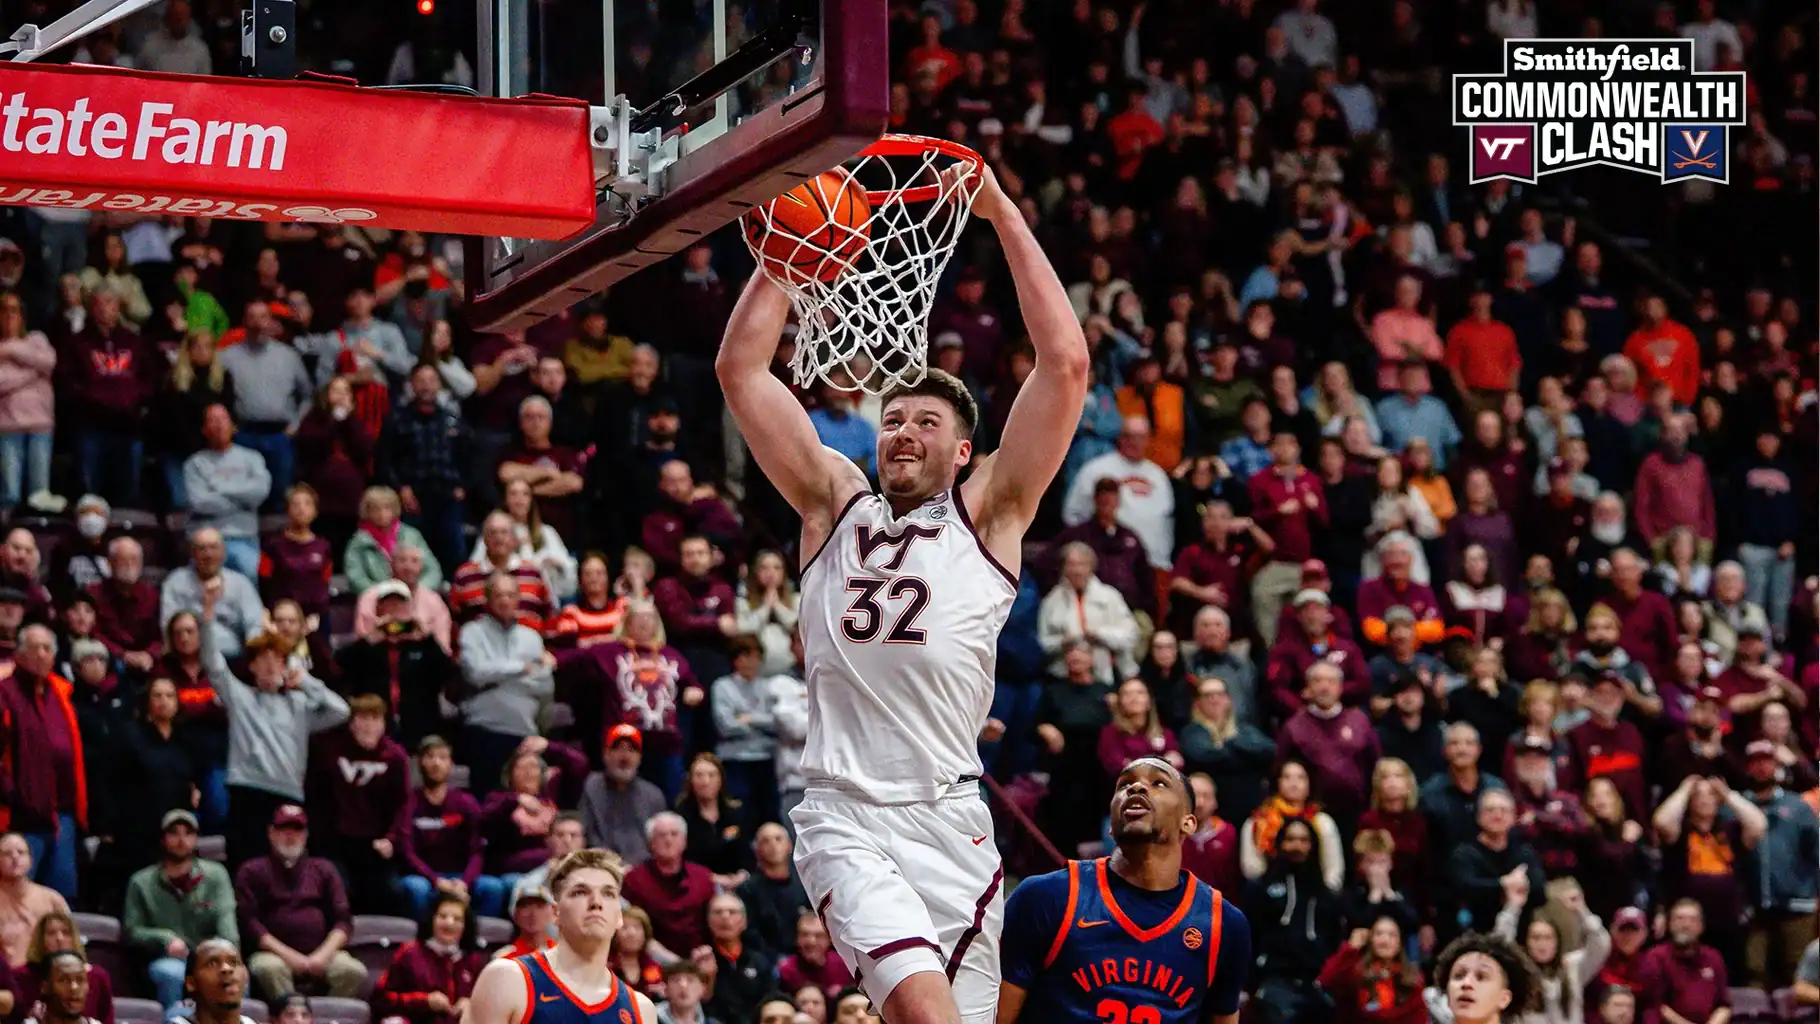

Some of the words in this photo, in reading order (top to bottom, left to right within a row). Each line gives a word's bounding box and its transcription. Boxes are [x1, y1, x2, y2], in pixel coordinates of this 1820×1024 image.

[0, 92, 128, 160] tate
[854, 522, 946, 573] VT
[841, 576, 931, 645] 32
[337, 756, 388, 787] VT
[1072, 957, 1195, 1009] VIRGINIA
